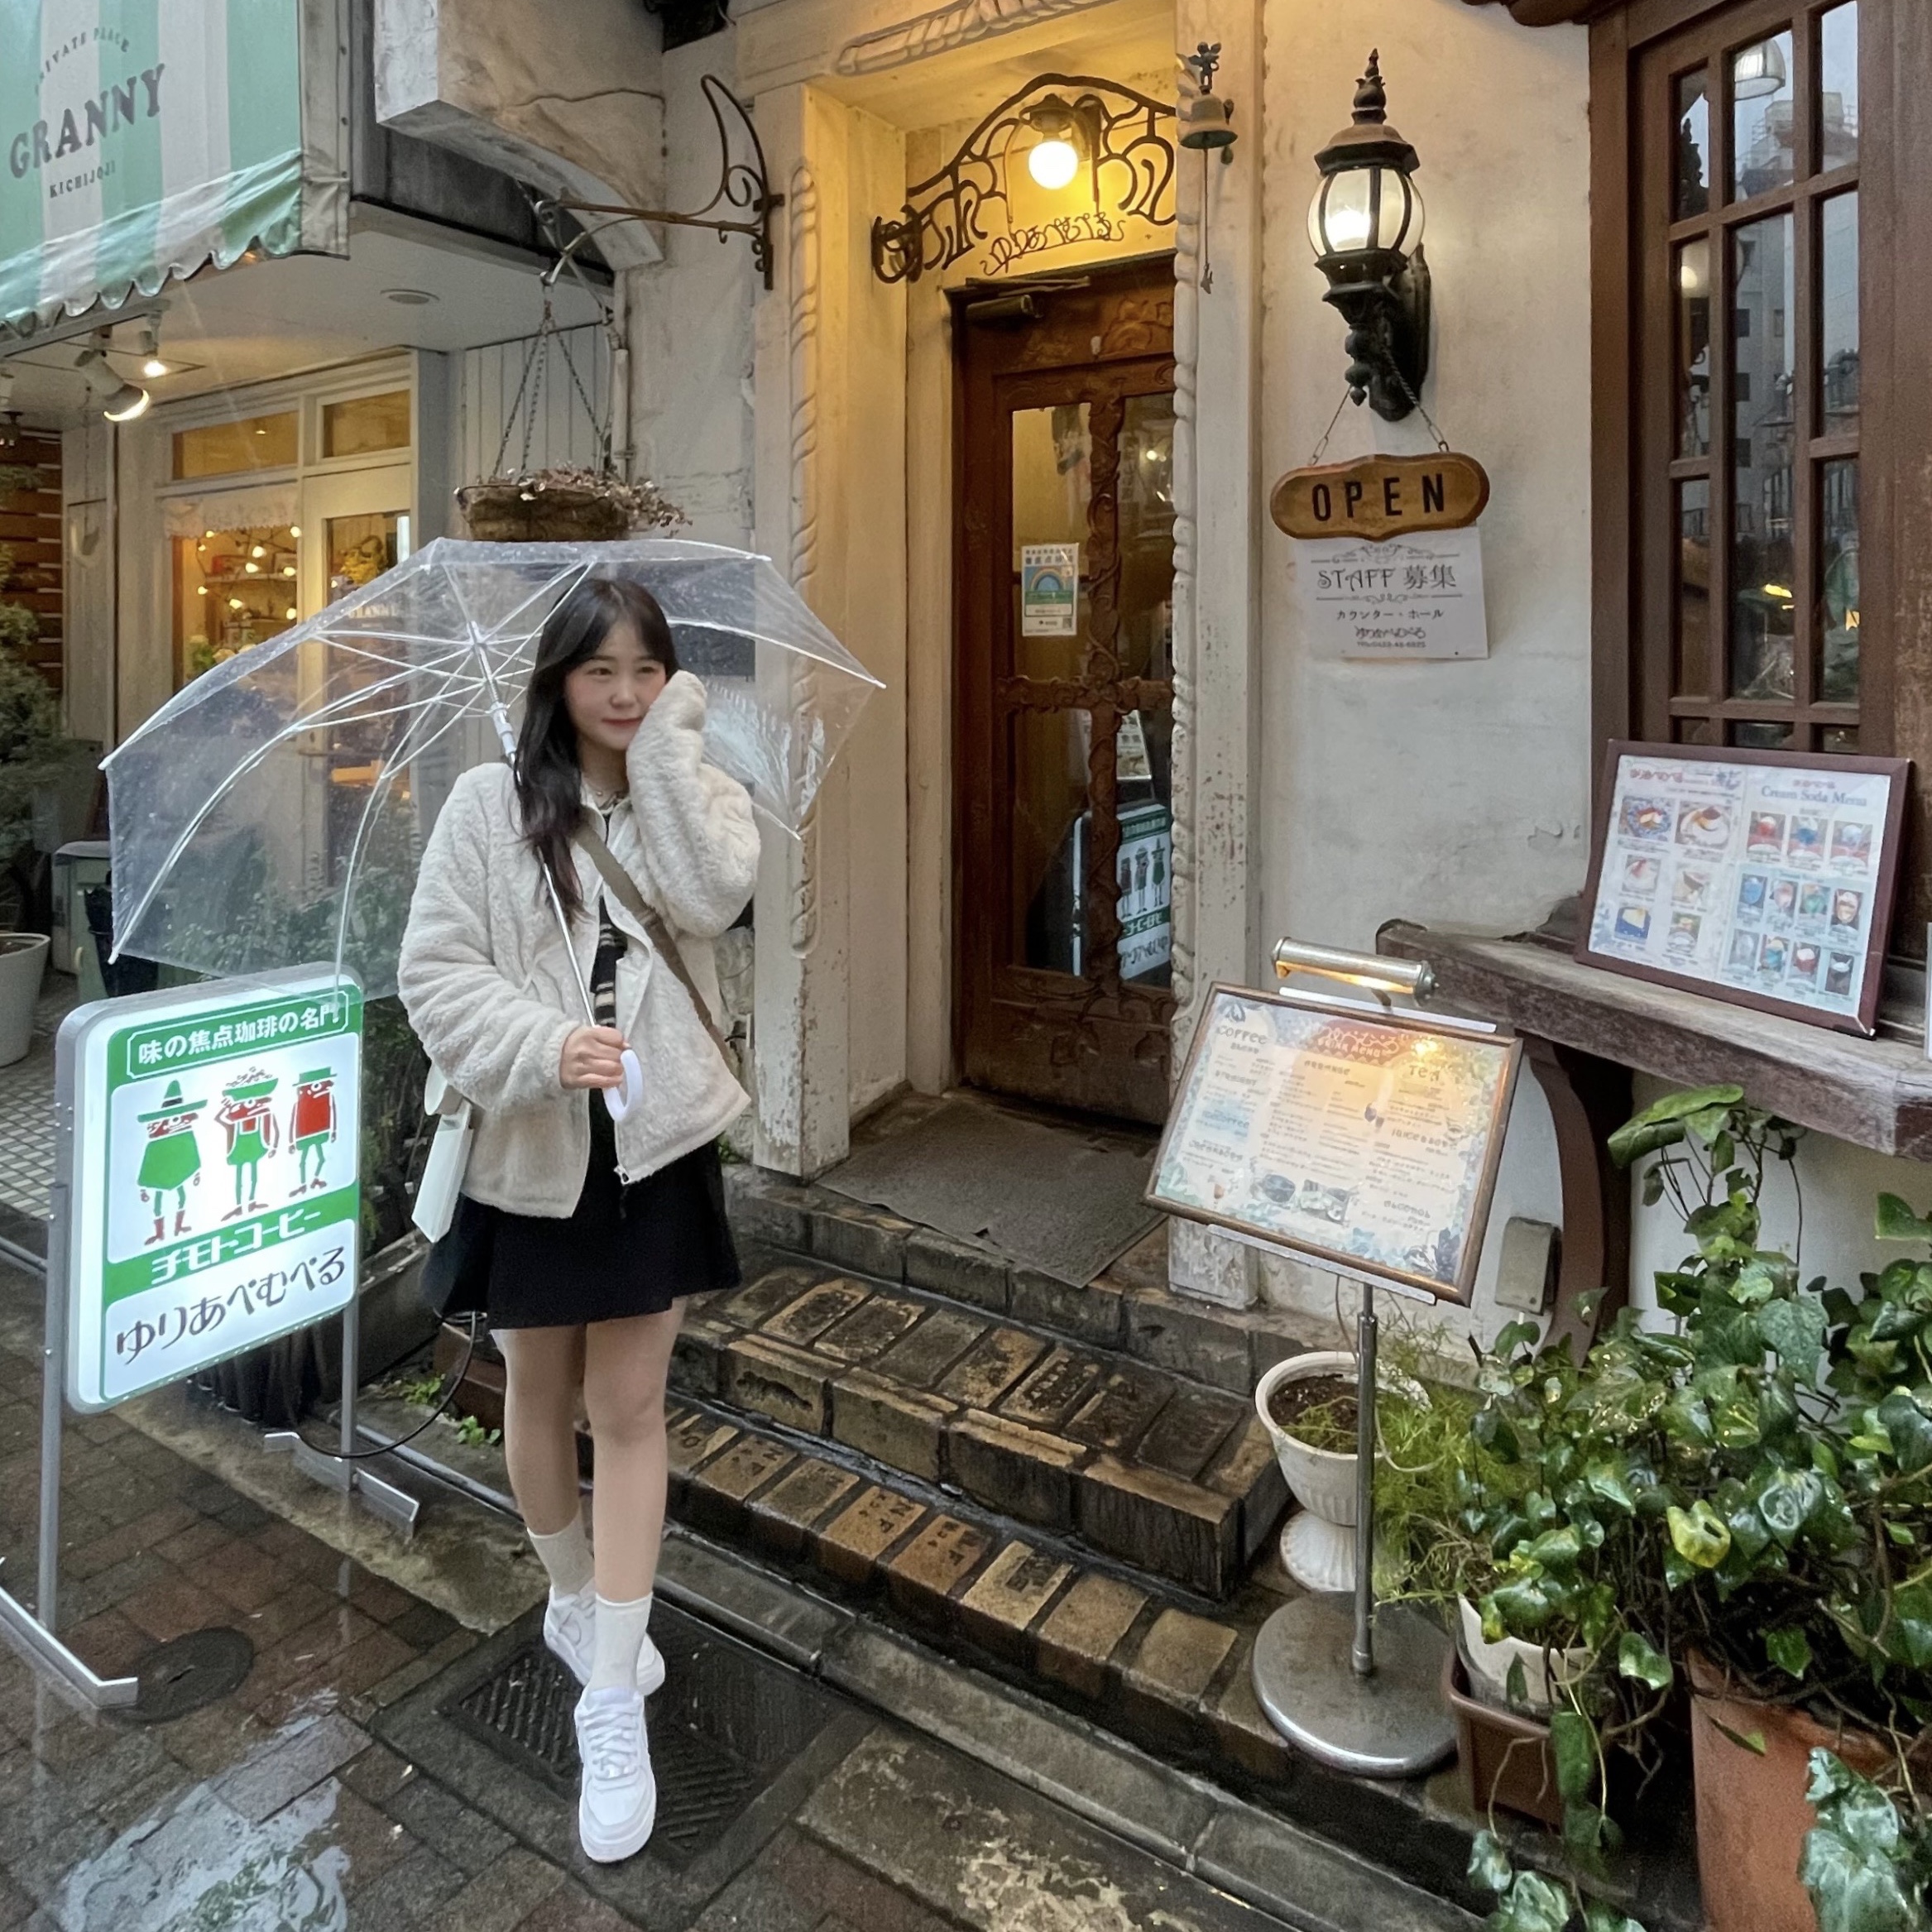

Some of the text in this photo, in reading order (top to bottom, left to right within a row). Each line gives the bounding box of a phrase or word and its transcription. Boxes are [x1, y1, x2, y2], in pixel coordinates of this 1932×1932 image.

[10, 64, 165, 178] GRANNY
[50, 161, 116, 199] KICHIJOJI
[1311, 473, 1445, 522] OPEN
[1317, 564, 1456, 592] STAFF 募集
[151, 1208, 321, 1285] チモトコーヒー
[117, 1246, 345, 1365] ゆりあぺむぺる
